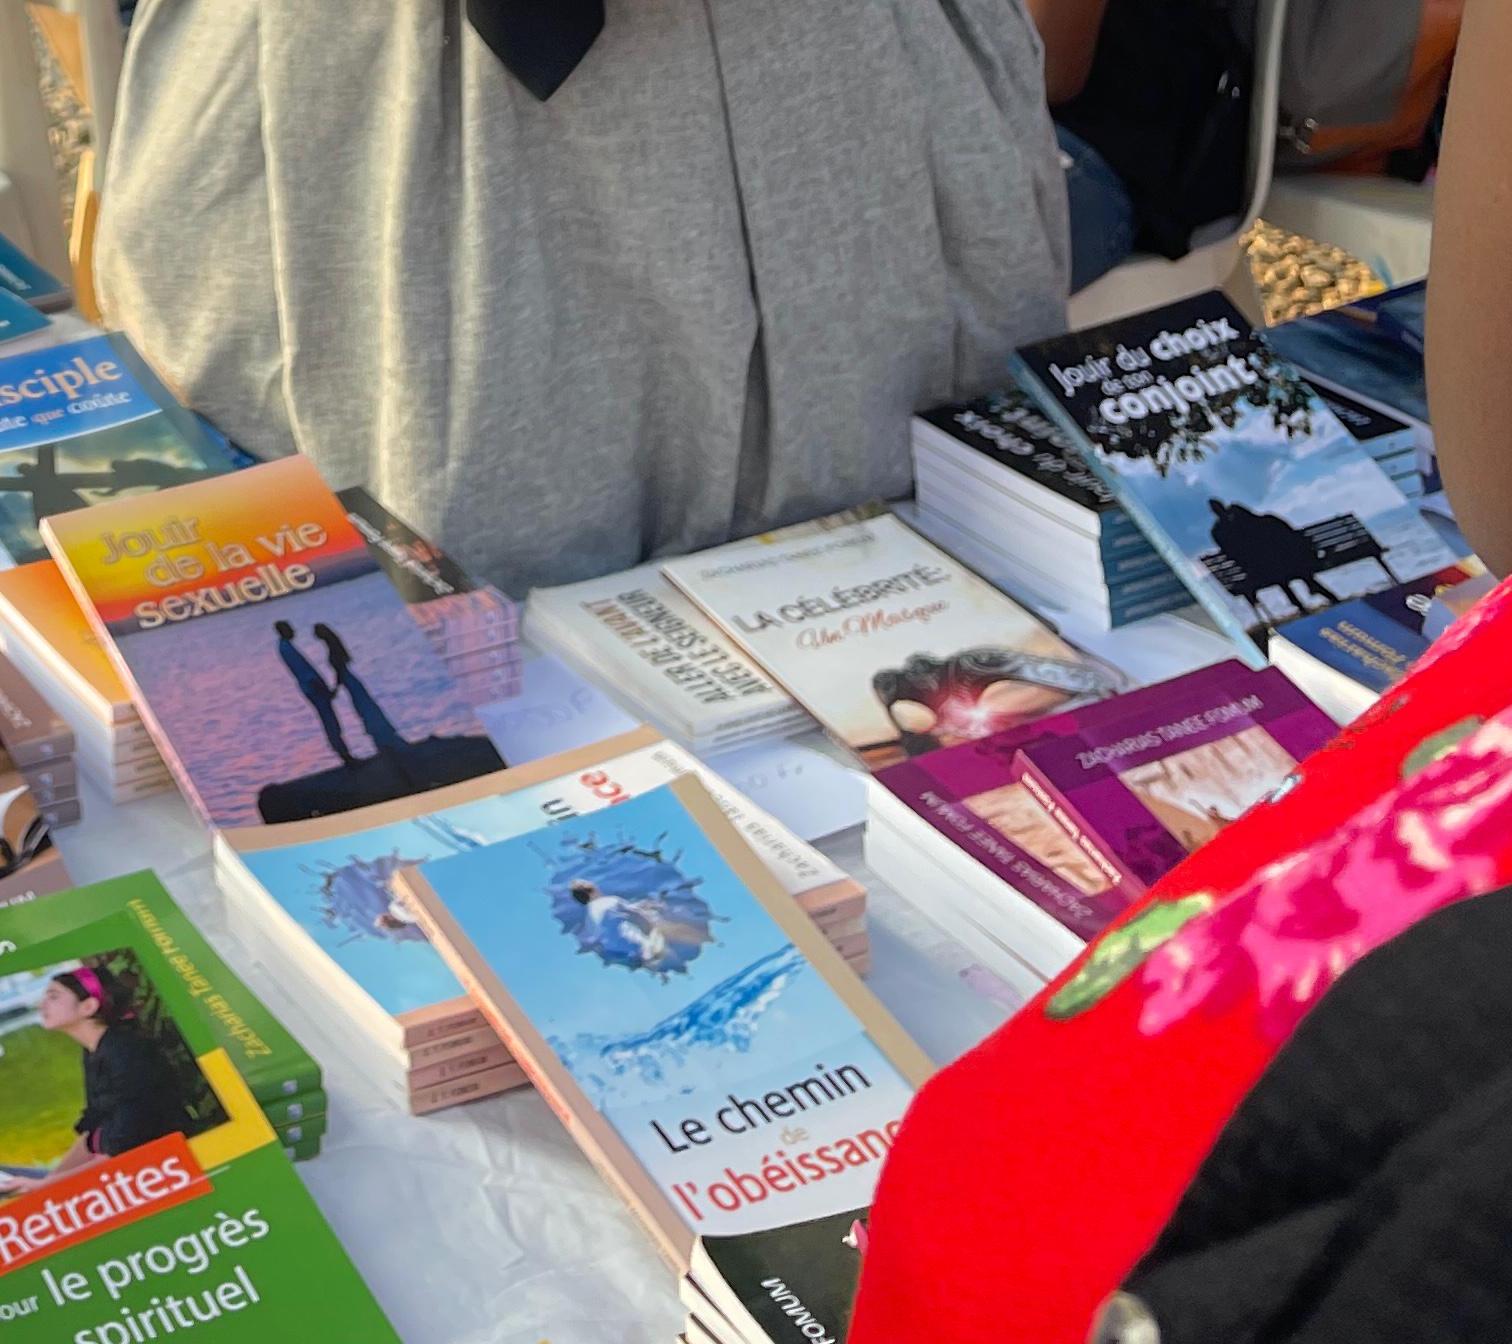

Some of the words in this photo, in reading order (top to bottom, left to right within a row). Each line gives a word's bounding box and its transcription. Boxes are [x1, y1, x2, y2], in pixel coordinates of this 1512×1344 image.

[1048, 353, 1114, 398] Jouir
[1115, 343, 1153, 372] du
[1149, 317, 1240, 362] choix
[1098, 353, 1259, 429] conjoint
[99, 514, 202, 565] Jouir
[144, 550, 205, 588] de
[205, 539, 257, 574] la
[257, 520, 329, 559] vie
[134, 561, 316, 630] sexuelle
[731, 610, 783, 635] LA
[172, 954, 214, 998] Tanee
[203, 992, 273, 1060] Zacharias
[649, 1118, 713, 1154] Le
[716, 1062, 873, 1135] chemin
[780, 1125, 810, 1145] de
[40, 1266, 94, 1310] le
[97, 1202, 271, 1297] progrès
[73, 1265, 262, 1344] spirituel
[760, 1277, 836, 1344] FOMUM
